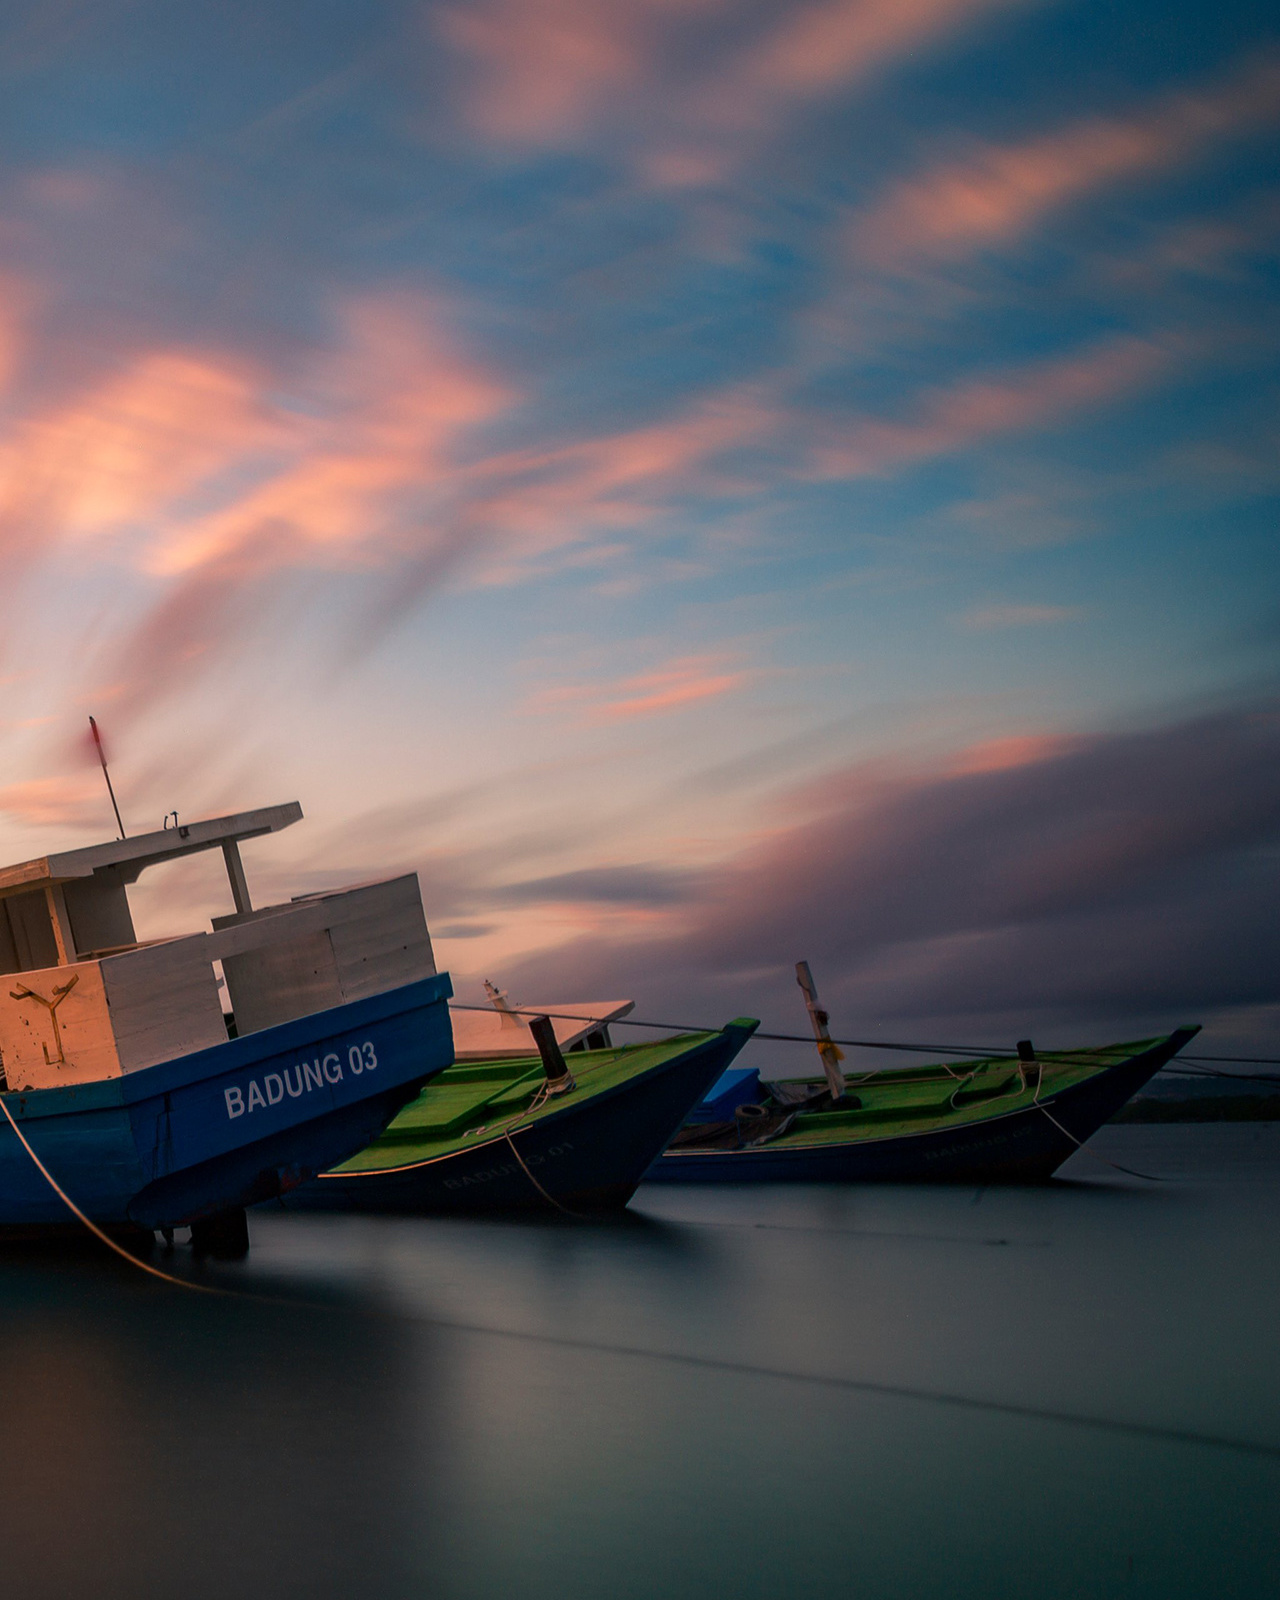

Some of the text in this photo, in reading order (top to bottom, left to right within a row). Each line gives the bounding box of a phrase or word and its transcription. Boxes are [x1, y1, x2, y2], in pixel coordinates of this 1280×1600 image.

[223, 1040, 378, 1120] BADUNG 03
[548, 1141, 575, 1156] 01
